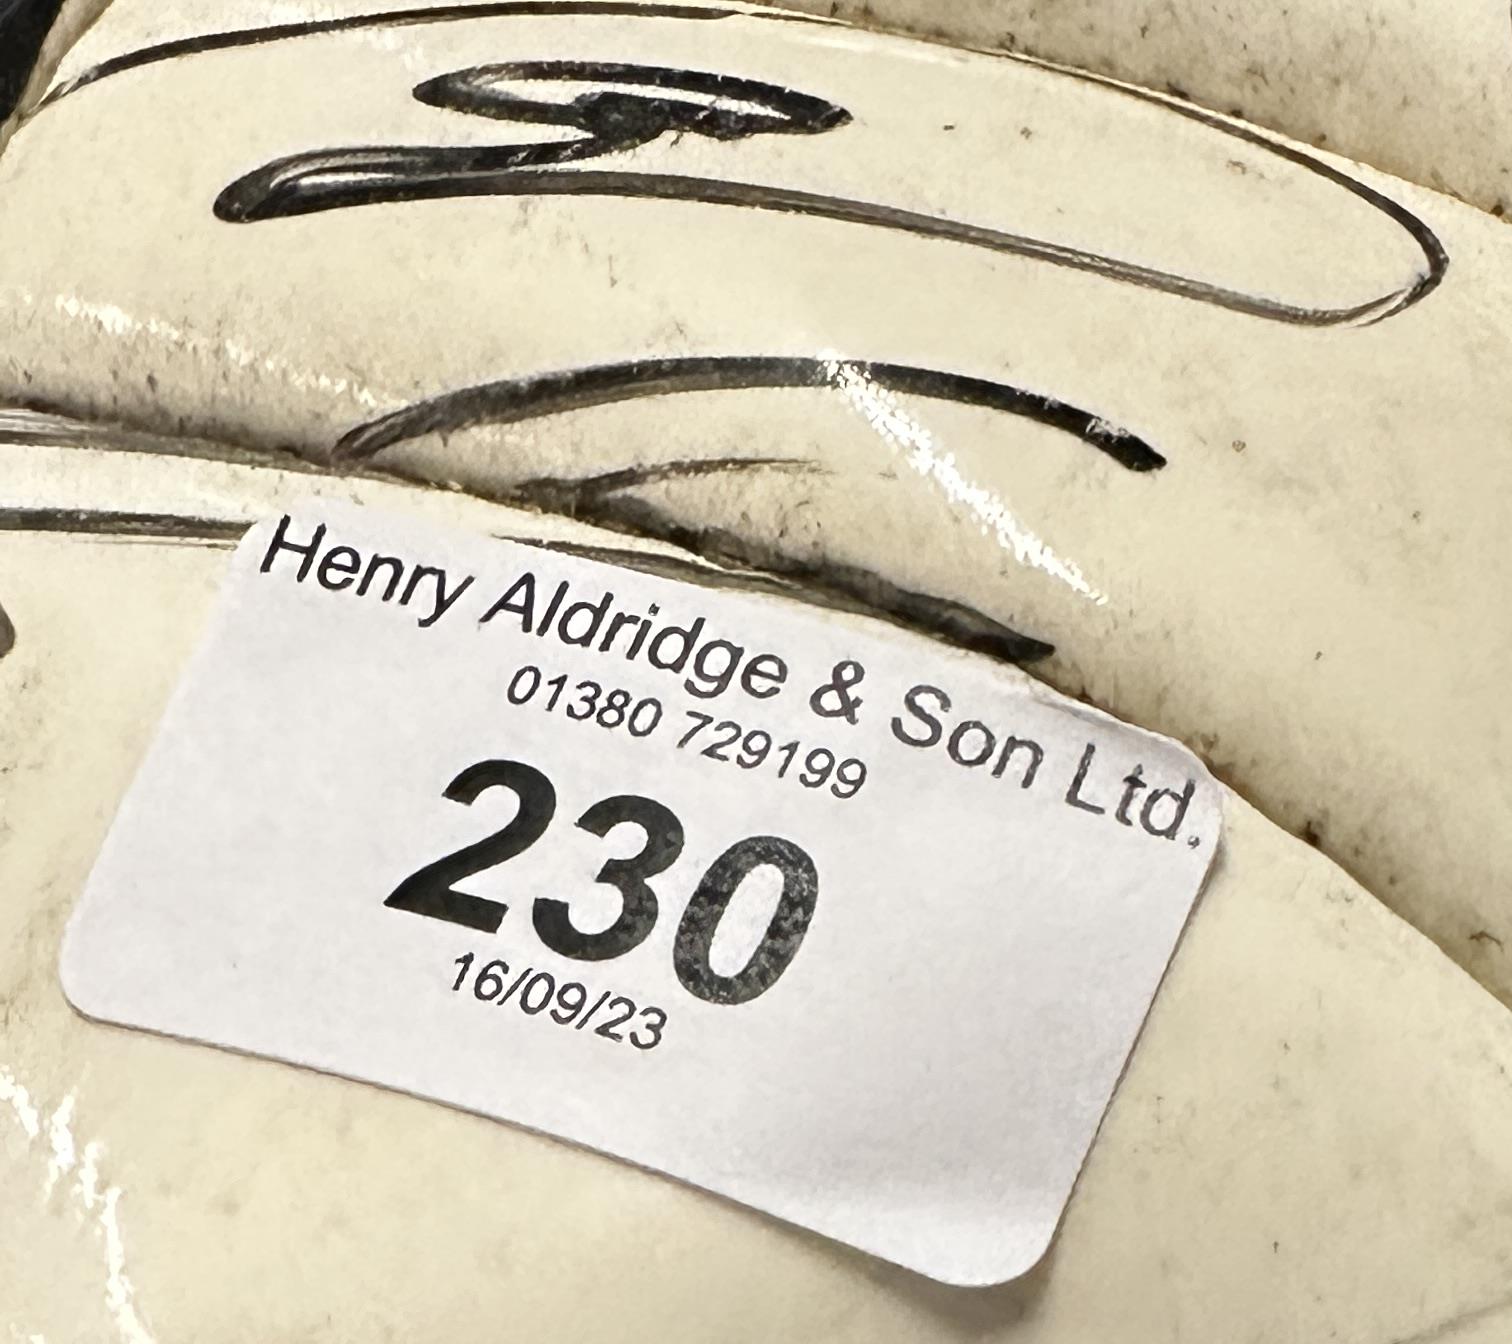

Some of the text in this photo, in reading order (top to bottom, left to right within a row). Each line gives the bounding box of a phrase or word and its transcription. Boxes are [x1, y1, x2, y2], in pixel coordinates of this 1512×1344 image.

[260, 514, 1203, 851] Henry Aldridge & Son Ltd.
[506, 665, 867, 799] 01380 729199
[382, 758, 819, 1006] 230
[451, 951, 669, 1050] 16/09/23
